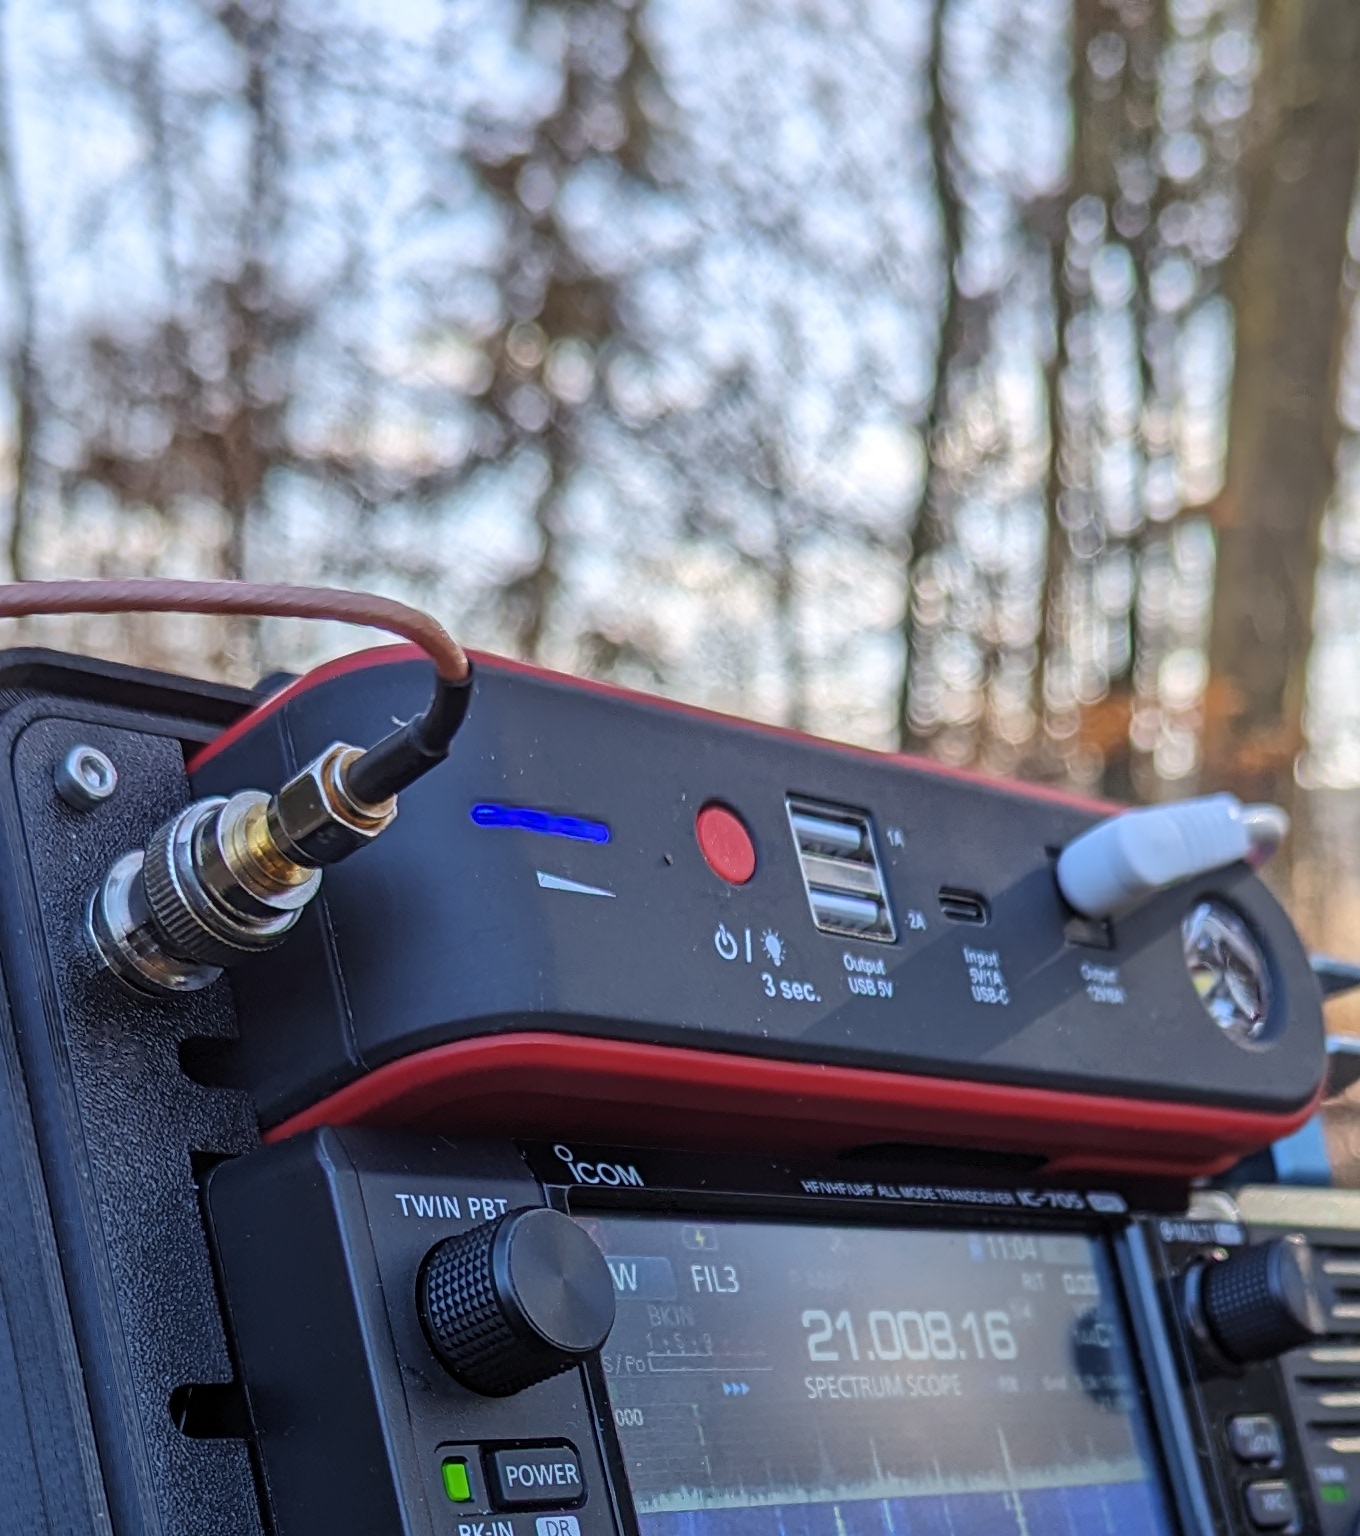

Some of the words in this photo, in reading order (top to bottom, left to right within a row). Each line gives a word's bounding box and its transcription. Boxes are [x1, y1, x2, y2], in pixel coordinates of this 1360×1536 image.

[907, 910, 926, 930] 2A
[843, 952, 886, 976] Output
[963, 947, 999, 967] Input
[761, 972, 776, 997] 3
[780, 981, 822, 1002] sec.
[848, 976, 877, 996] USB
[878, 980, 893, 998] 5V
[971, 985, 1009, 1005] USB-C
[395, 1193, 461, 1219] TWIN
[468, 1197, 507, 1220] PBT
[900, 1185, 938, 1200] MODE
[1016, 1190, 1086, 1210] IC-705
[691, 1265, 740, 1293] FIL3
[802, 1310, 1017, 1361] 21.008.16
[804, 1375, 903, 1399] SPECTRUM
[907, 1374, 963, 1396] SCOPE
[505, 1463, 580, 1487] POWER
